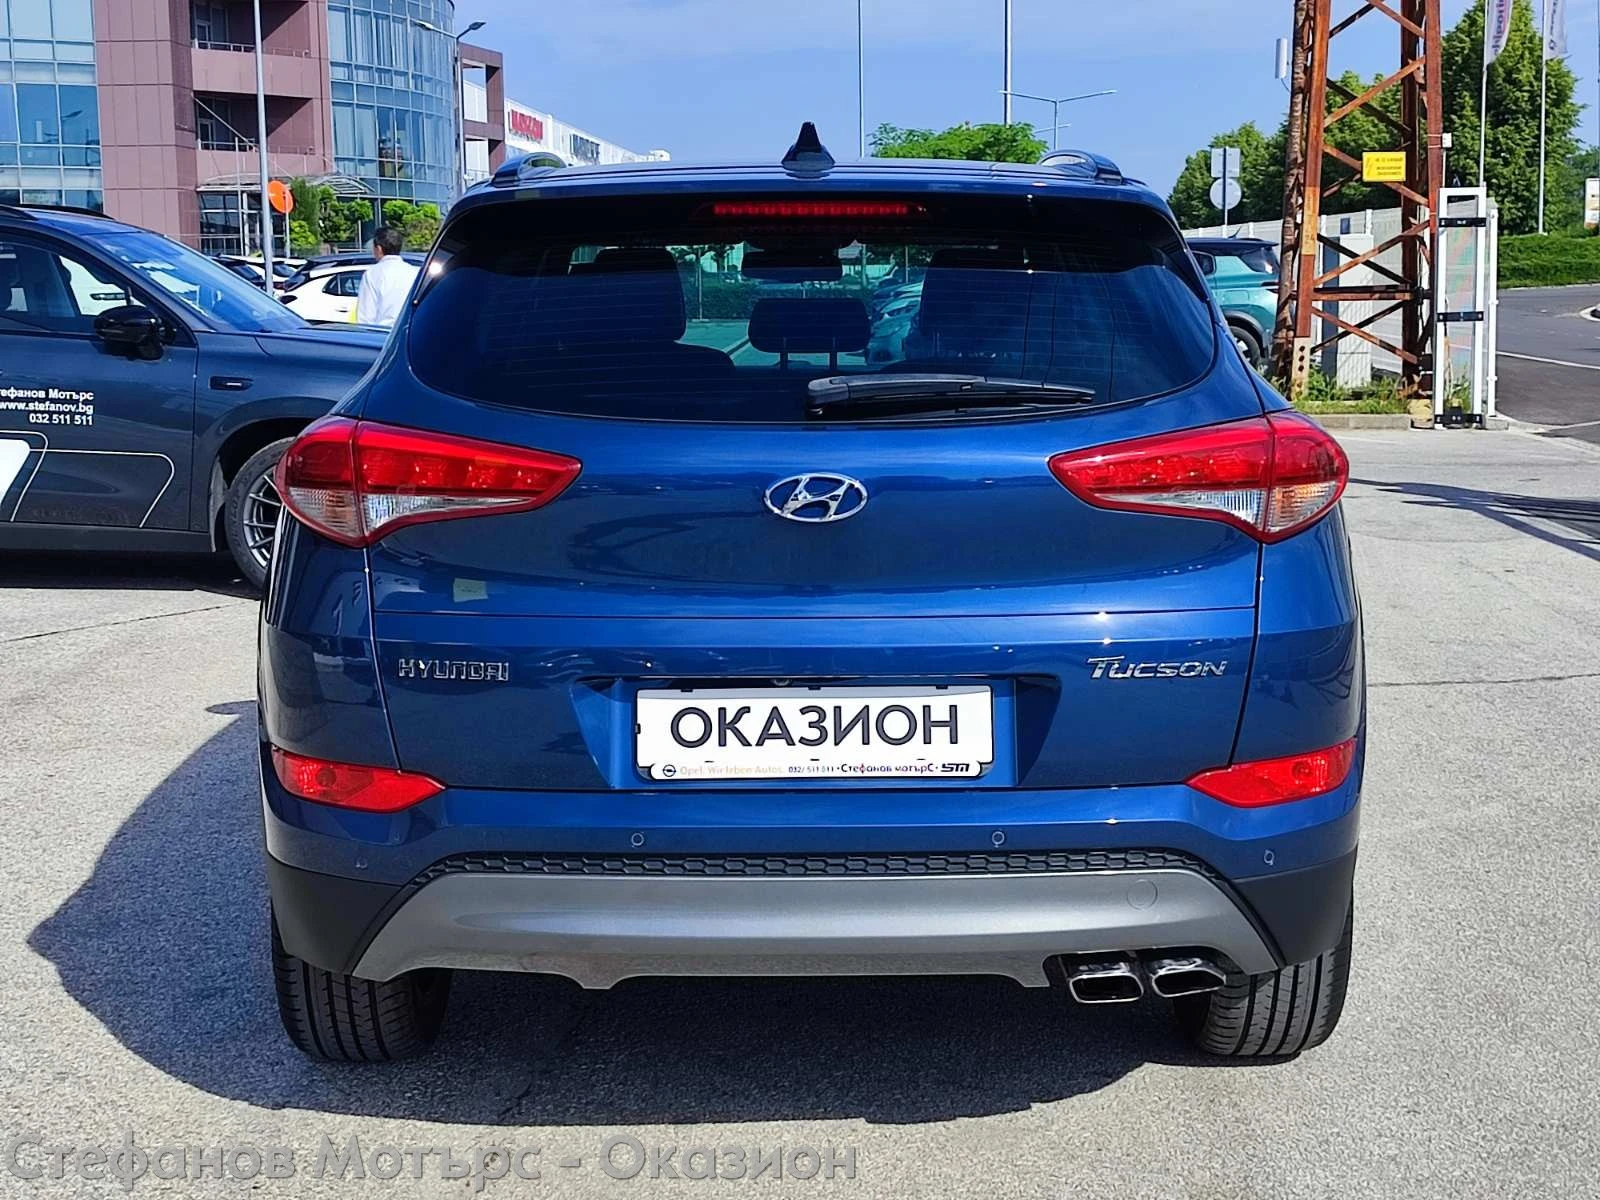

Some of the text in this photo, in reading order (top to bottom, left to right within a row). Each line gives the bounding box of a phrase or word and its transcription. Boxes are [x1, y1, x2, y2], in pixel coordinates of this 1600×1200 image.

[0, 387, 94, 401] ефанов Мотърс
[0, 401, 94, 415] www.stefanov.bg
[29, 413, 93, 426] 032 511 511
[399, 659, 509, 681] HYUNDAI
[670, 704, 959, 748] ОКАЗИОН
